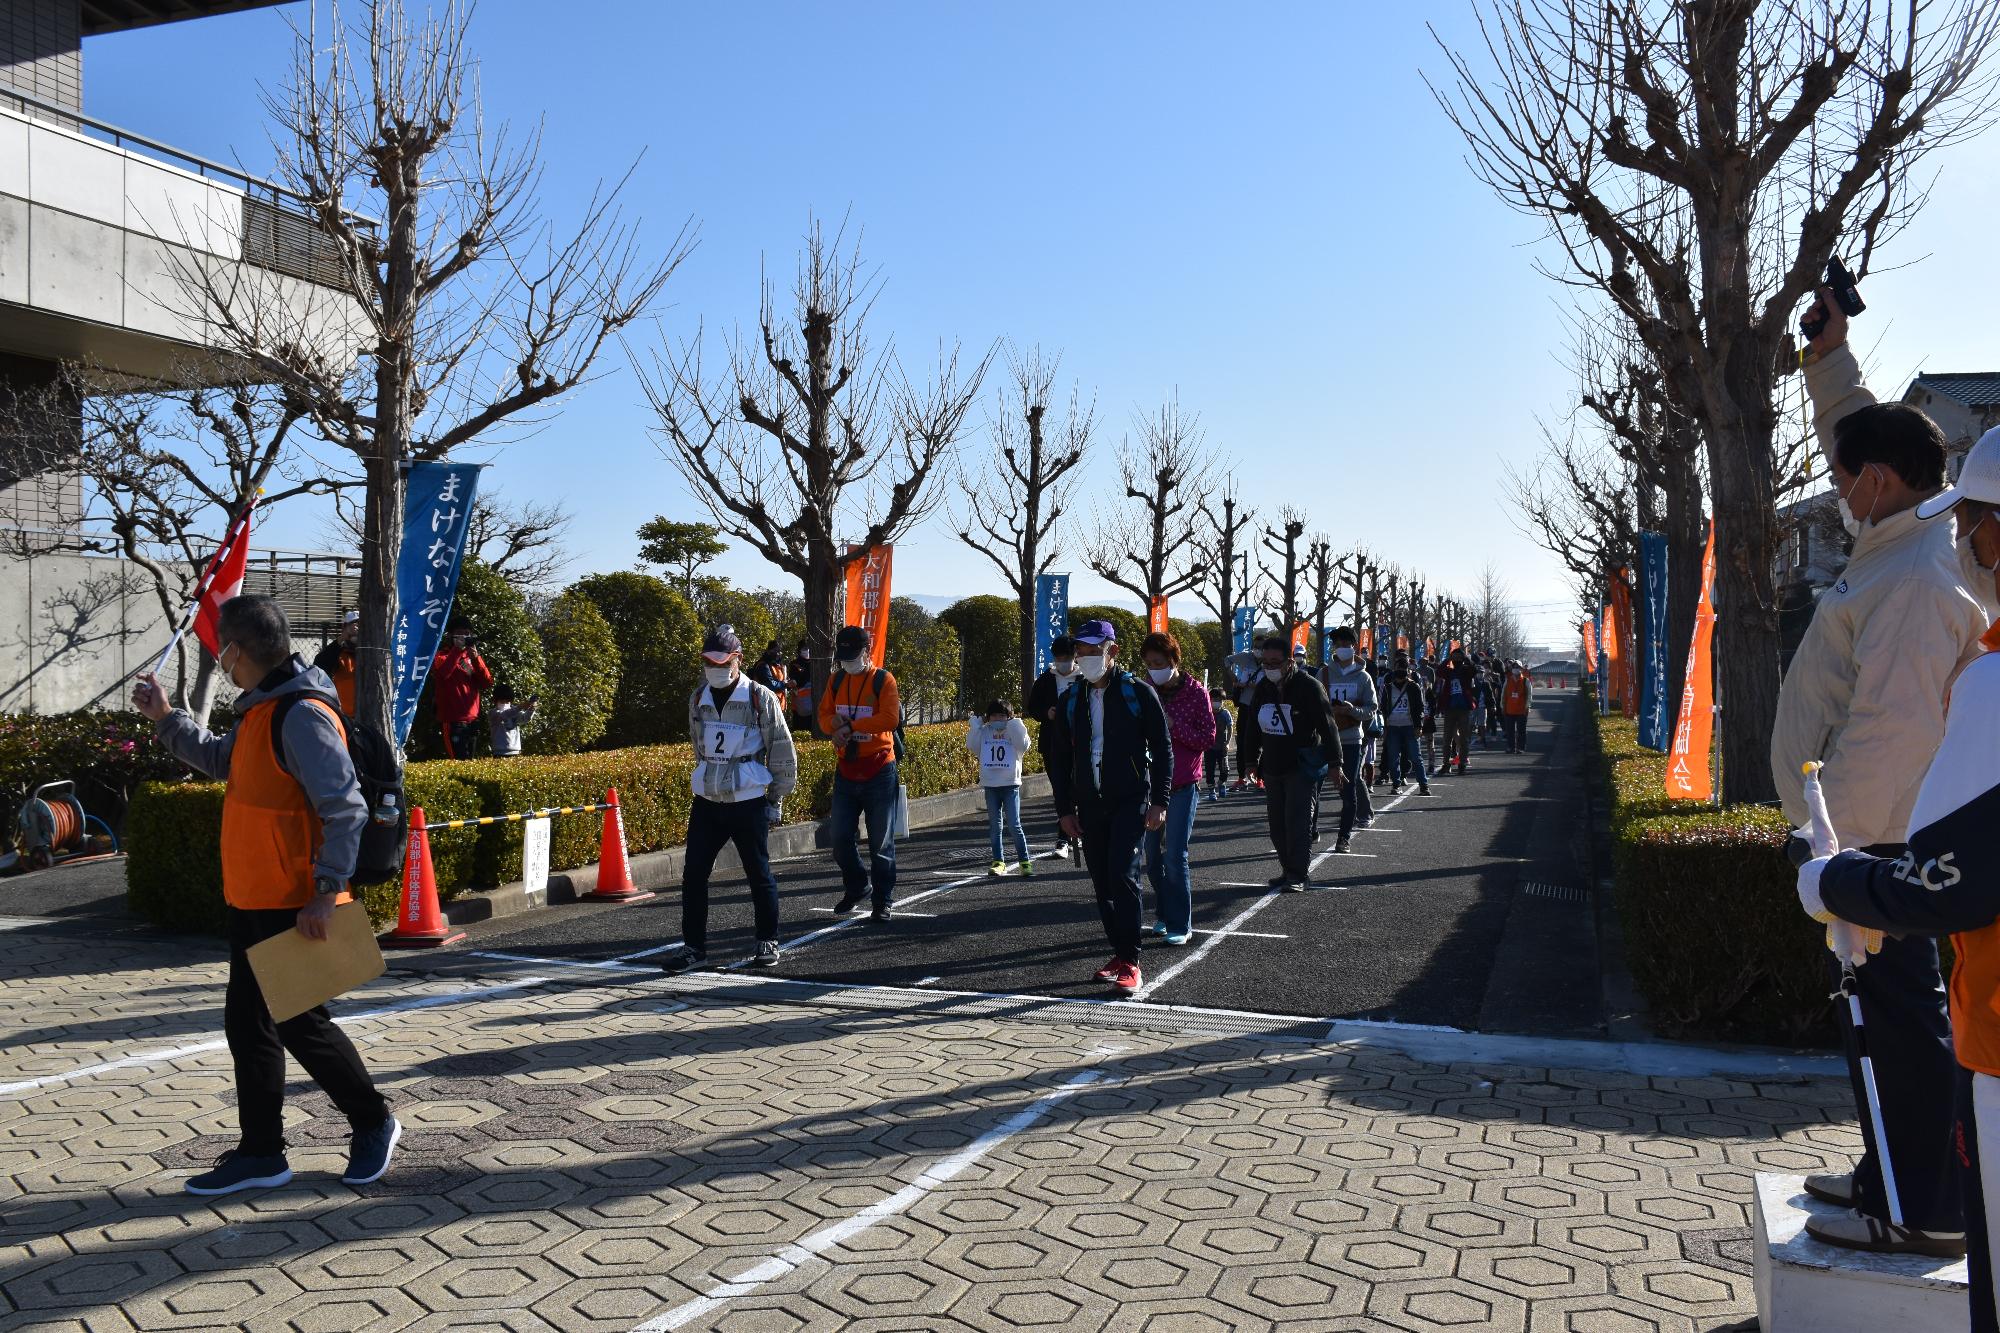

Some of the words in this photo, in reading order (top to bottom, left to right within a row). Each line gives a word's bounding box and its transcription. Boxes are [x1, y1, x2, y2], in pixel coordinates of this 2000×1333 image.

[1271, 710, 1279, 727] 5
[714, 731, 725, 754] 2
[990, 746, 1006, 762] 10
[407, 830, 421, 921] 大和郡山市体育協会
